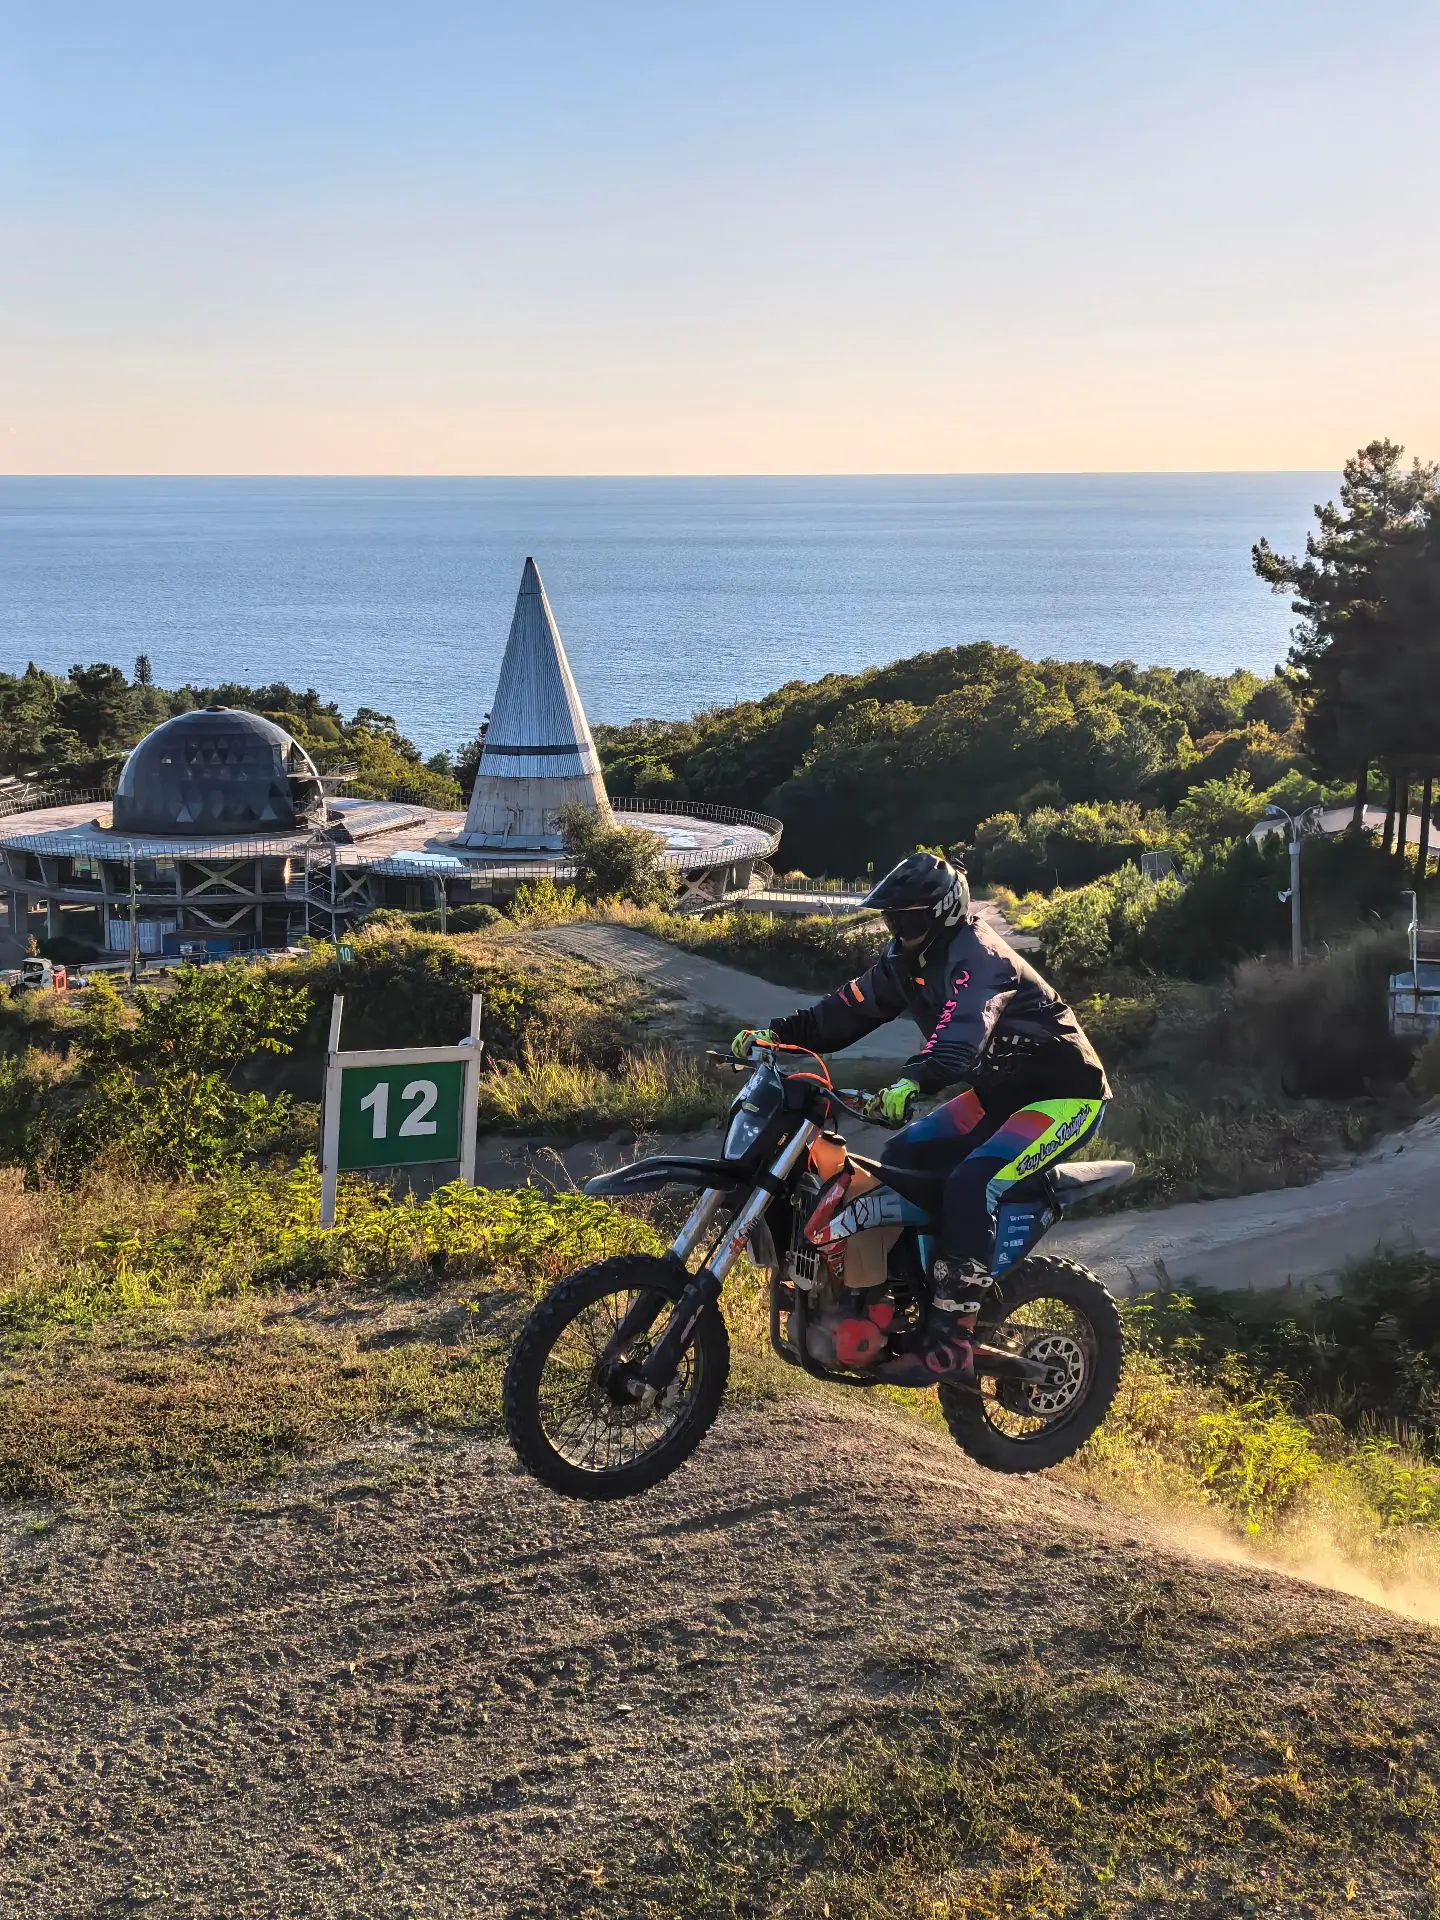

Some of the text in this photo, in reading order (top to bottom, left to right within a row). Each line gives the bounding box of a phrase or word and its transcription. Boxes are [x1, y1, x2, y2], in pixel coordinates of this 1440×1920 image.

[339, 946, 351, 961] 10
[360, 1079, 438, 1139] 12
[1039, 1141, 1059, 1161] Lee
